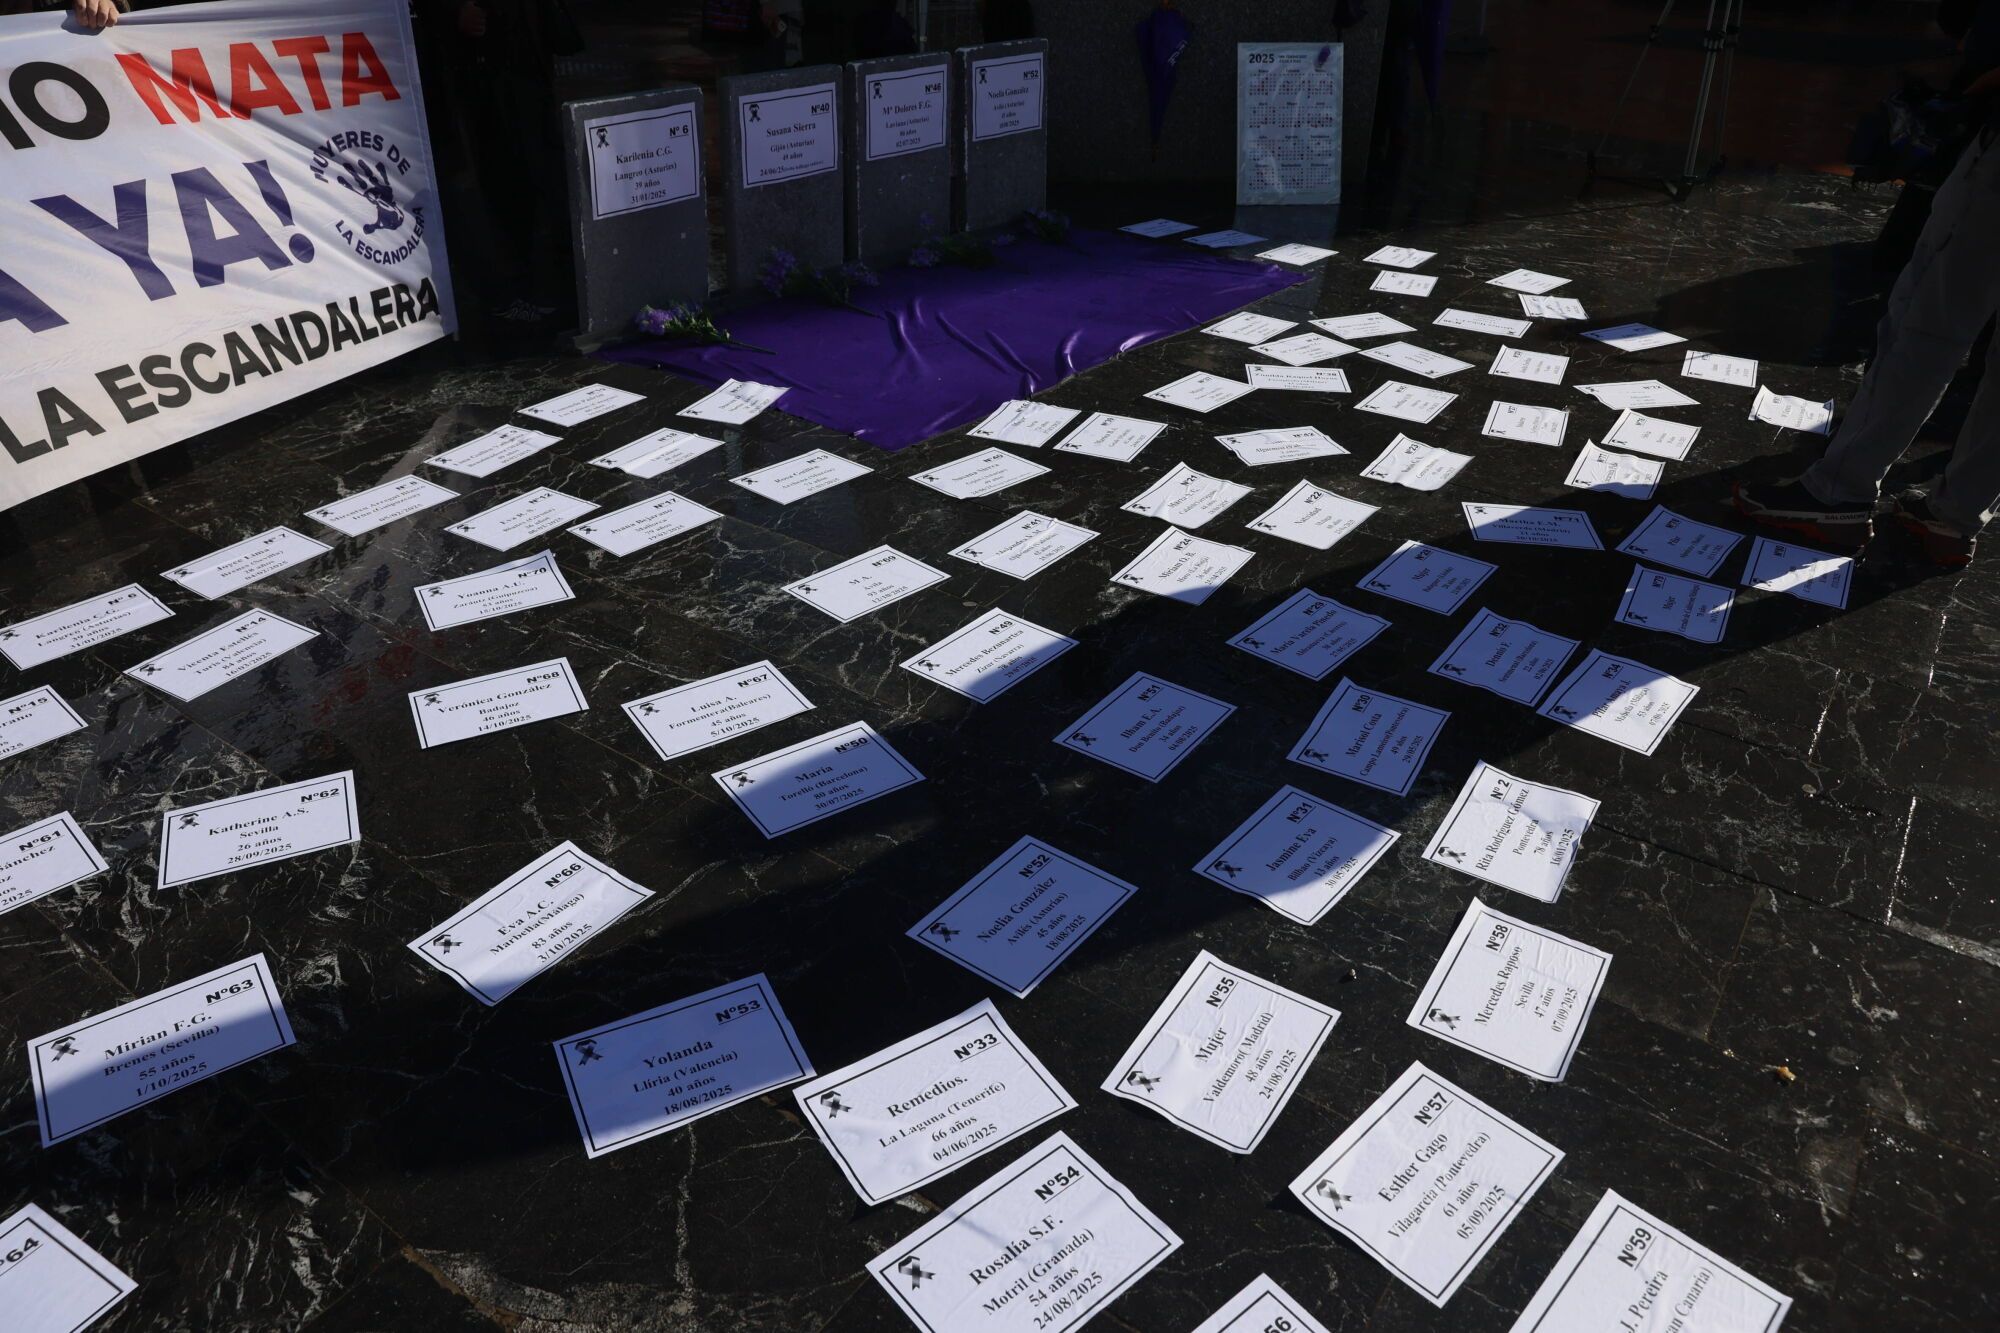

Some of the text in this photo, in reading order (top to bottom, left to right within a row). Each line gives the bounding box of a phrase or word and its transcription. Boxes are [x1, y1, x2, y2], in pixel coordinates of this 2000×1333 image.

[1248, 54, 1275, 64] 2025
[114, 32, 400, 125] MATA
[894, 103, 918, 115] Dolores
[669, 124, 689, 137] Nº 6
[766, 122, 816, 137] Susana Sierra
[310, 130, 411, 184] MUYERES DE
[614, 161, 678, 182] Langreo (Asturias)
[615, 145, 673, 165] Karilenia C.G.
[635, 178, 661, 189] 39 años
[30, 159, 315, 301] YA!
[336, 207, 424, 264] LA ESCANDALERA
[0, 386, 106, 464] LA
[94, 277, 441, 424] ESCANDALERA
[243, 548, 270, 560] Lima
[35, 618, 91, 640] Karilenia
[37, 611, 132, 647] Langreo (Asturias)
[944, 654, 984, 676] Mercedes
[437, 683, 551, 714] Verónica González
[1590, 701, 1610, 719] Pilar
[1605, 684, 1632, 703] Amaya
[478, 714, 532, 732] 14/10/2025
[668, 694, 772, 730] Formentera(Baleares)
[710, 717, 760, 738] 5/10/2025
[834, 737, 869, 754] Nº50
[1344, 713, 1383, 756] Marisol Costa
[794, 766, 834, 783] María
[814, 766, 868, 789] (Barcelona)
[1489, 778, 1511, 800] Nº 2
[814, 787, 864, 810] 30/07/2025
[1286, 801, 1313, 824] Nº31
[209, 807, 309, 836] Katherine A.S.
[239, 825, 279, 838] Sevilla
[1474, 788, 1530, 872] Rita Rodríguez Gómez
[1511, 815, 1540, 856] Pontevedra
[18, 830, 62, 852] Nº61
[228, 843, 292, 865] 28/09/2025
[1265, 828, 1318, 872] Jasmine Eva
[1549, 828, 1575, 866] 16/01/2025
[544, 862, 582, 888] Nº66
[1018, 854, 1051, 878] Nº52
[1287, 837, 1338, 882] Bilbao (Vizcaya)
[1324, 854, 1359, 889] 30/05/2025
[489, 893, 585, 953] Marbella(Málaga)
[497, 900, 554, 936] Eva A.C.
[976, 876, 1057, 943] Noelia González
[1007, 892, 1069, 945] Avilés (Asturias)
[1036, 913, 1067, 939] 45 años
[531, 922, 573, 950] 83 años
[537, 923, 593, 963] 3/10/2025
[1045, 914, 1087, 951] 18/08/2025
[1485, 924, 1509, 952] Nº58
[205, 979, 254, 1004] Nº63
[1205, 976, 1235, 1008] Nº55
[1473, 946, 1523, 1023] Mercedes Raposo
[1514, 981, 1536, 1009] Sevilla
[715, 999, 761, 1023] Nº53
[1533, 988, 1555, 1018] 47 años
[1551, 986, 1578, 1033] 07/09/2025
[104, 1012, 212, 1060] Mirian F.G.
[953, 1033, 998, 1060] Nº33
[1194, 1027, 1227, 1059] Mujer
[1240, 1012, 1274, 1047] Madrid)
[103, 1025, 220, 1077] Brenes (Sevilla)
[138, 1054, 196, 1081] 55 años
[642, 1040, 714, 1069] Yolanda
[1244, 1049, 1274, 1083] 48 años
[136, 1061, 208, 1097] 1/10/2025
[633, 1050, 738, 1093] Llíria (Valencia)
[667, 1076, 716, 1097] 40 años
[1258, 1049, 1297, 1100] 24/08/2025
[664, 1084, 733, 1116] 18/08/2025
[878, 1082, 1006, 1148] La Laguna (Tenerife)
[886, 1077, 968, 1118] Remedios.
[1413, 1091, 1448, 1126] Nº57
[931, 1117, 978, 1142] 66 años
[932, 1123, 998, 1161] 04/06/2025
[1377, 1133, 1448, 1203] Esther Gago
[1433, 1132, 1491, 1192] (Pontevedra)
[1034, 1165, 1080, 1201] Nº54
[1442, 1181, 1480, 1218] 61 años
[1456, 1184, 1506, 1240] 05/09/2025
[968, 1214, 1064, 1286] Rosalía S.F.
[1616, 1227, 1652, 1268] Nº59
[982, 1228, 1095, 1312] Motril (Granada)
[1028, 1268, 1079, 1308] 54 años
[1033, 1271, 1103, 1330] 24/08/2025
[1627, 1270, 1669, 1320] Pereira
[1674, 1266, 1714, 1317] Canaria)
